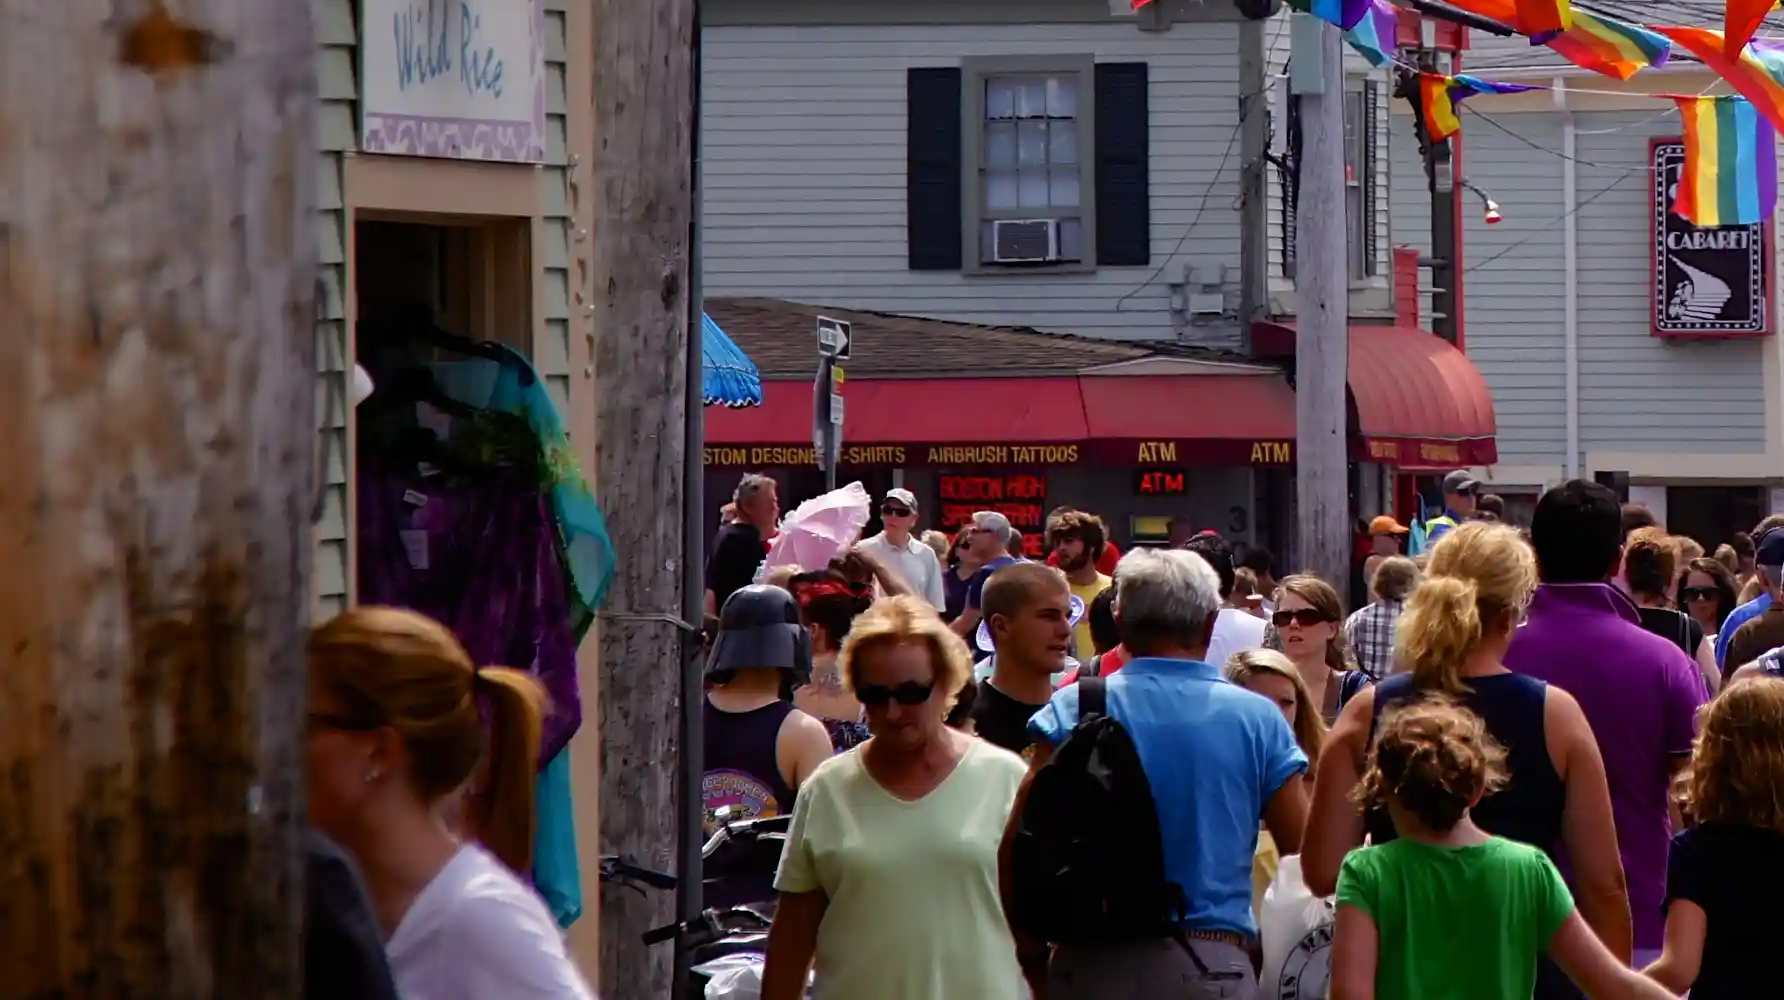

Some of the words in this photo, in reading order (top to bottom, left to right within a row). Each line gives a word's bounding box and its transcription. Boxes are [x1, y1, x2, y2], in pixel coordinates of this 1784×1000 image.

[461, 1, 503, 99] Rice
[1667, 230, 1750, 250] CABARET
[703, 448, 746, 465] STOM
[752, 446, 824, 465] DESIGNE
[928, 446, 1007, 463] AIRBRUSH
[1012, 444, 1078, 463] TATTOOS
[1138, 441, 1176, 463] ATM
[1251, 441, 1290, 463] ATM
[940, 476, 1003, 499] BOSTON
[1140, 473, 1183, 492] ATM
